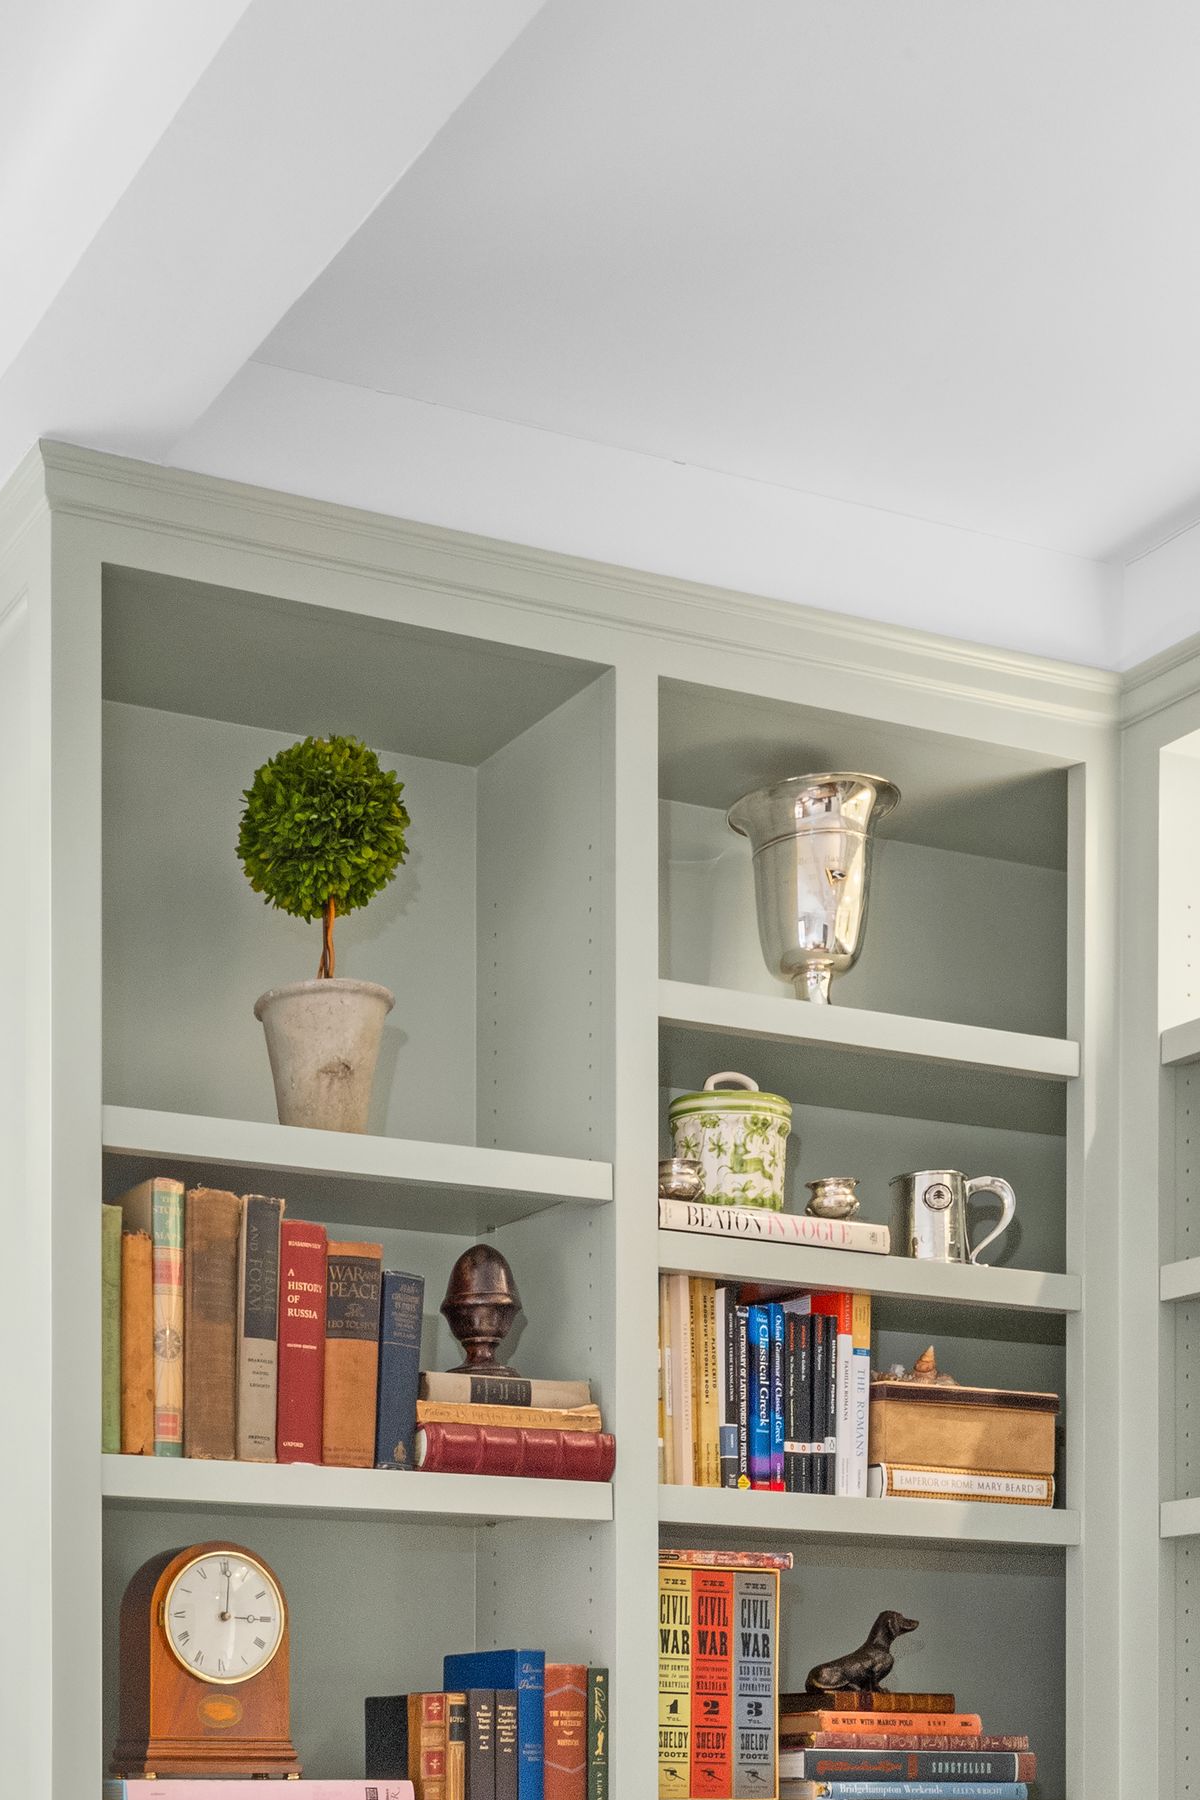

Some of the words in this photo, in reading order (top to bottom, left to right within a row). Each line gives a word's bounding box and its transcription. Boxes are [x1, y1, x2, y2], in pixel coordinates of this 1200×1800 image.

[686, 1206, 762, 1233] BEATON
[767, 1216, 785, 1236] IN
[791, 1217, 852, 1245] VOGUE
[250, 1226, 259, 1251] AND
[288, 1268, 295, 1277] A
[329, 1265, 364, 1281] WAR
[249, 1260, 263, 1311] FORM
[288, 1282, 323, 1294] HISTORY
[329, 1282, 378, 1300] PEACE
[287, 1294, 300, 1304] OF
[287, 1308, 318, 1320] RUSSIA
[328, 1319, 343, 1328] LEO
[760, 1325, 769, 1384] Classical
[774, 1342, 782, 1377] Grammar
[740, 1368, 746, 1377] OF
[857, 1369, 866, 1393] THE
[775, 1378, 782, 1387] of
[760, 1389, 769, 1426] Greek
[856, 1400, 865, 1457] ROMANS
[900, 1475, 939, 1488] EMPEROR
[952, 1479, 974, 1489] ROME
[977, 1482, 1002, 1490] MARY
[1005, 1483, 1034, 1493] BEARD
[660, 1594, 690, 1625] CIVIL
[698, 1596, 728, 1627] CIVIL
[741, 1598, 770, 1629] CIVIL
[660, 1629, 690, 1654] WAR
[697, 1631, 728, 1656] WAR
[741, 1633, 770, 1658] WAR
[666, 1699, 680, 1714] 1
[703, 1700, 719, 1715] 2
[747, 1701, 763, 1717] 3
[659, 1731, 688, 1748] SHELBY
[696, 1732, 726, 1750] SHELBY
[740, 1734, 769, 1750] SHELBY
[931, 1762, 992, 1774] SONGTELLER
[839, 1783, 902, 1796] Bridgehampton
[903, 1785, 943, 1794] Weekends
